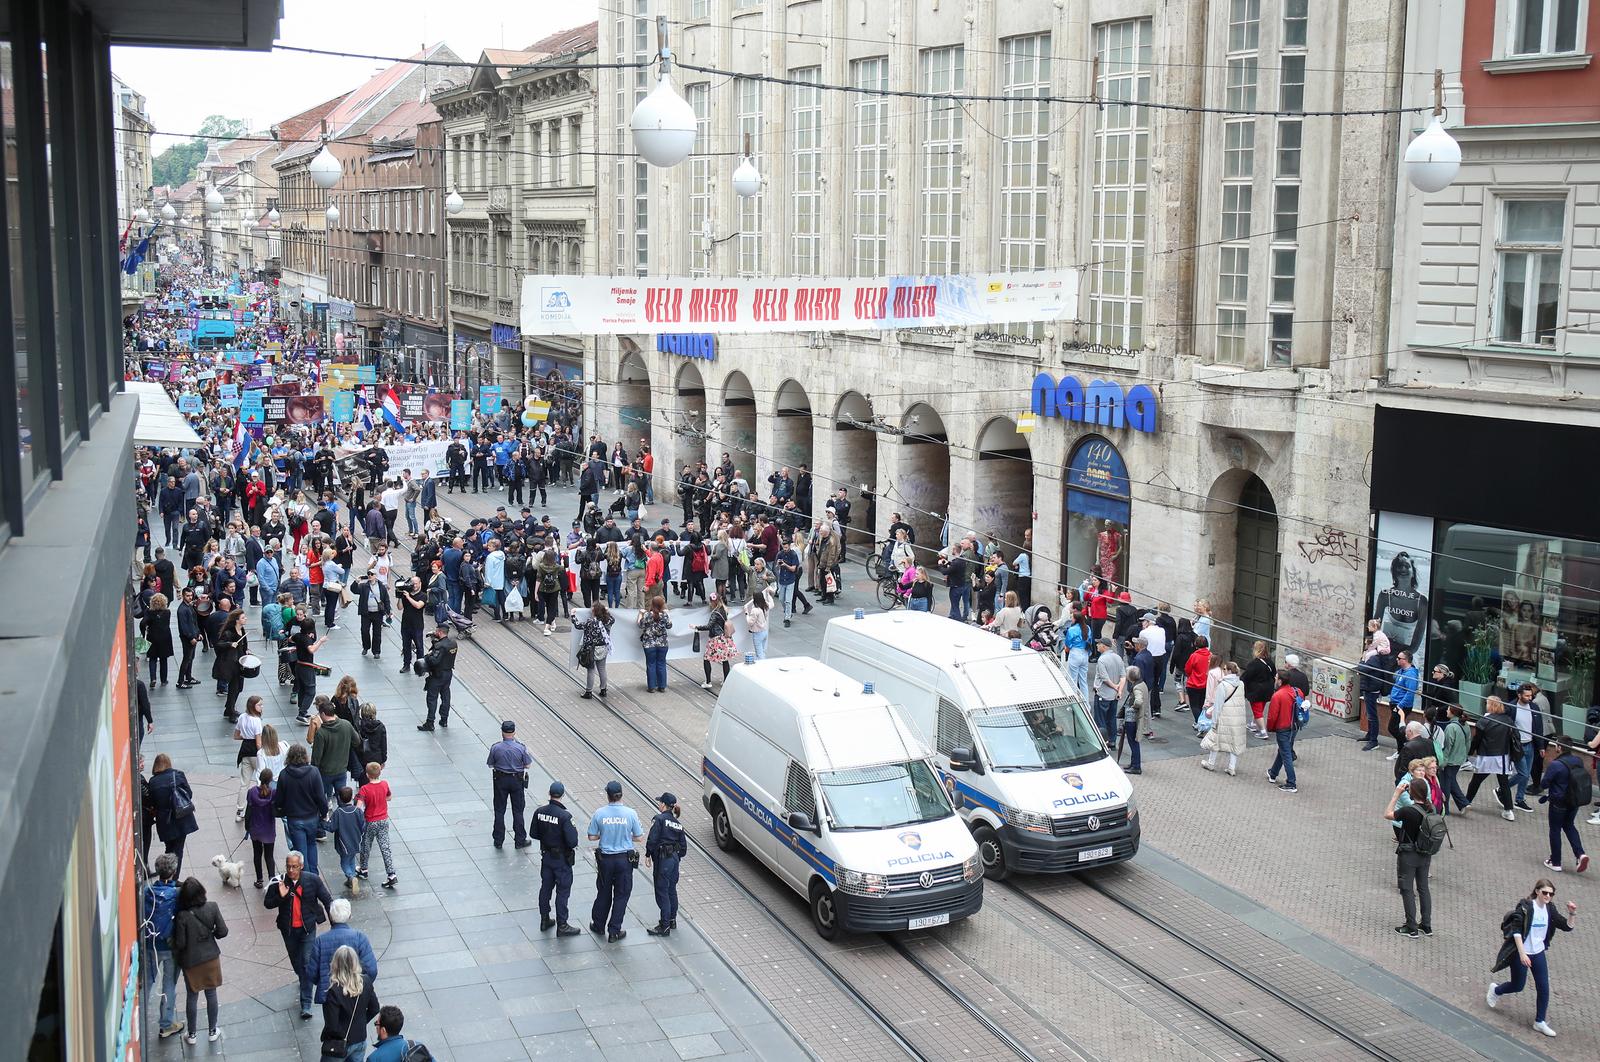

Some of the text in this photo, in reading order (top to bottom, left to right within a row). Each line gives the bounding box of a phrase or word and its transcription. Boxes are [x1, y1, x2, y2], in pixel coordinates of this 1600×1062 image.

[611, 287, 637, 296] Miljenko
[645, 285, 937, 323] VELO MISTO VELO MISTO VELO MISTO
[540, 312, 572, 320] KOMEDIJA
[1031, 372, 1158, 433] nama
[1087, 443, 1112, 462] 140
[1387, 606, 1415, 618] RADOST
[1052, 790, 1119, 809] POLICIJA
[603, 816, 627, 825] POLICIJA
[743, 797, 774, 829] POLICIJA
[887, 850, 954, 868] POLICIJA
